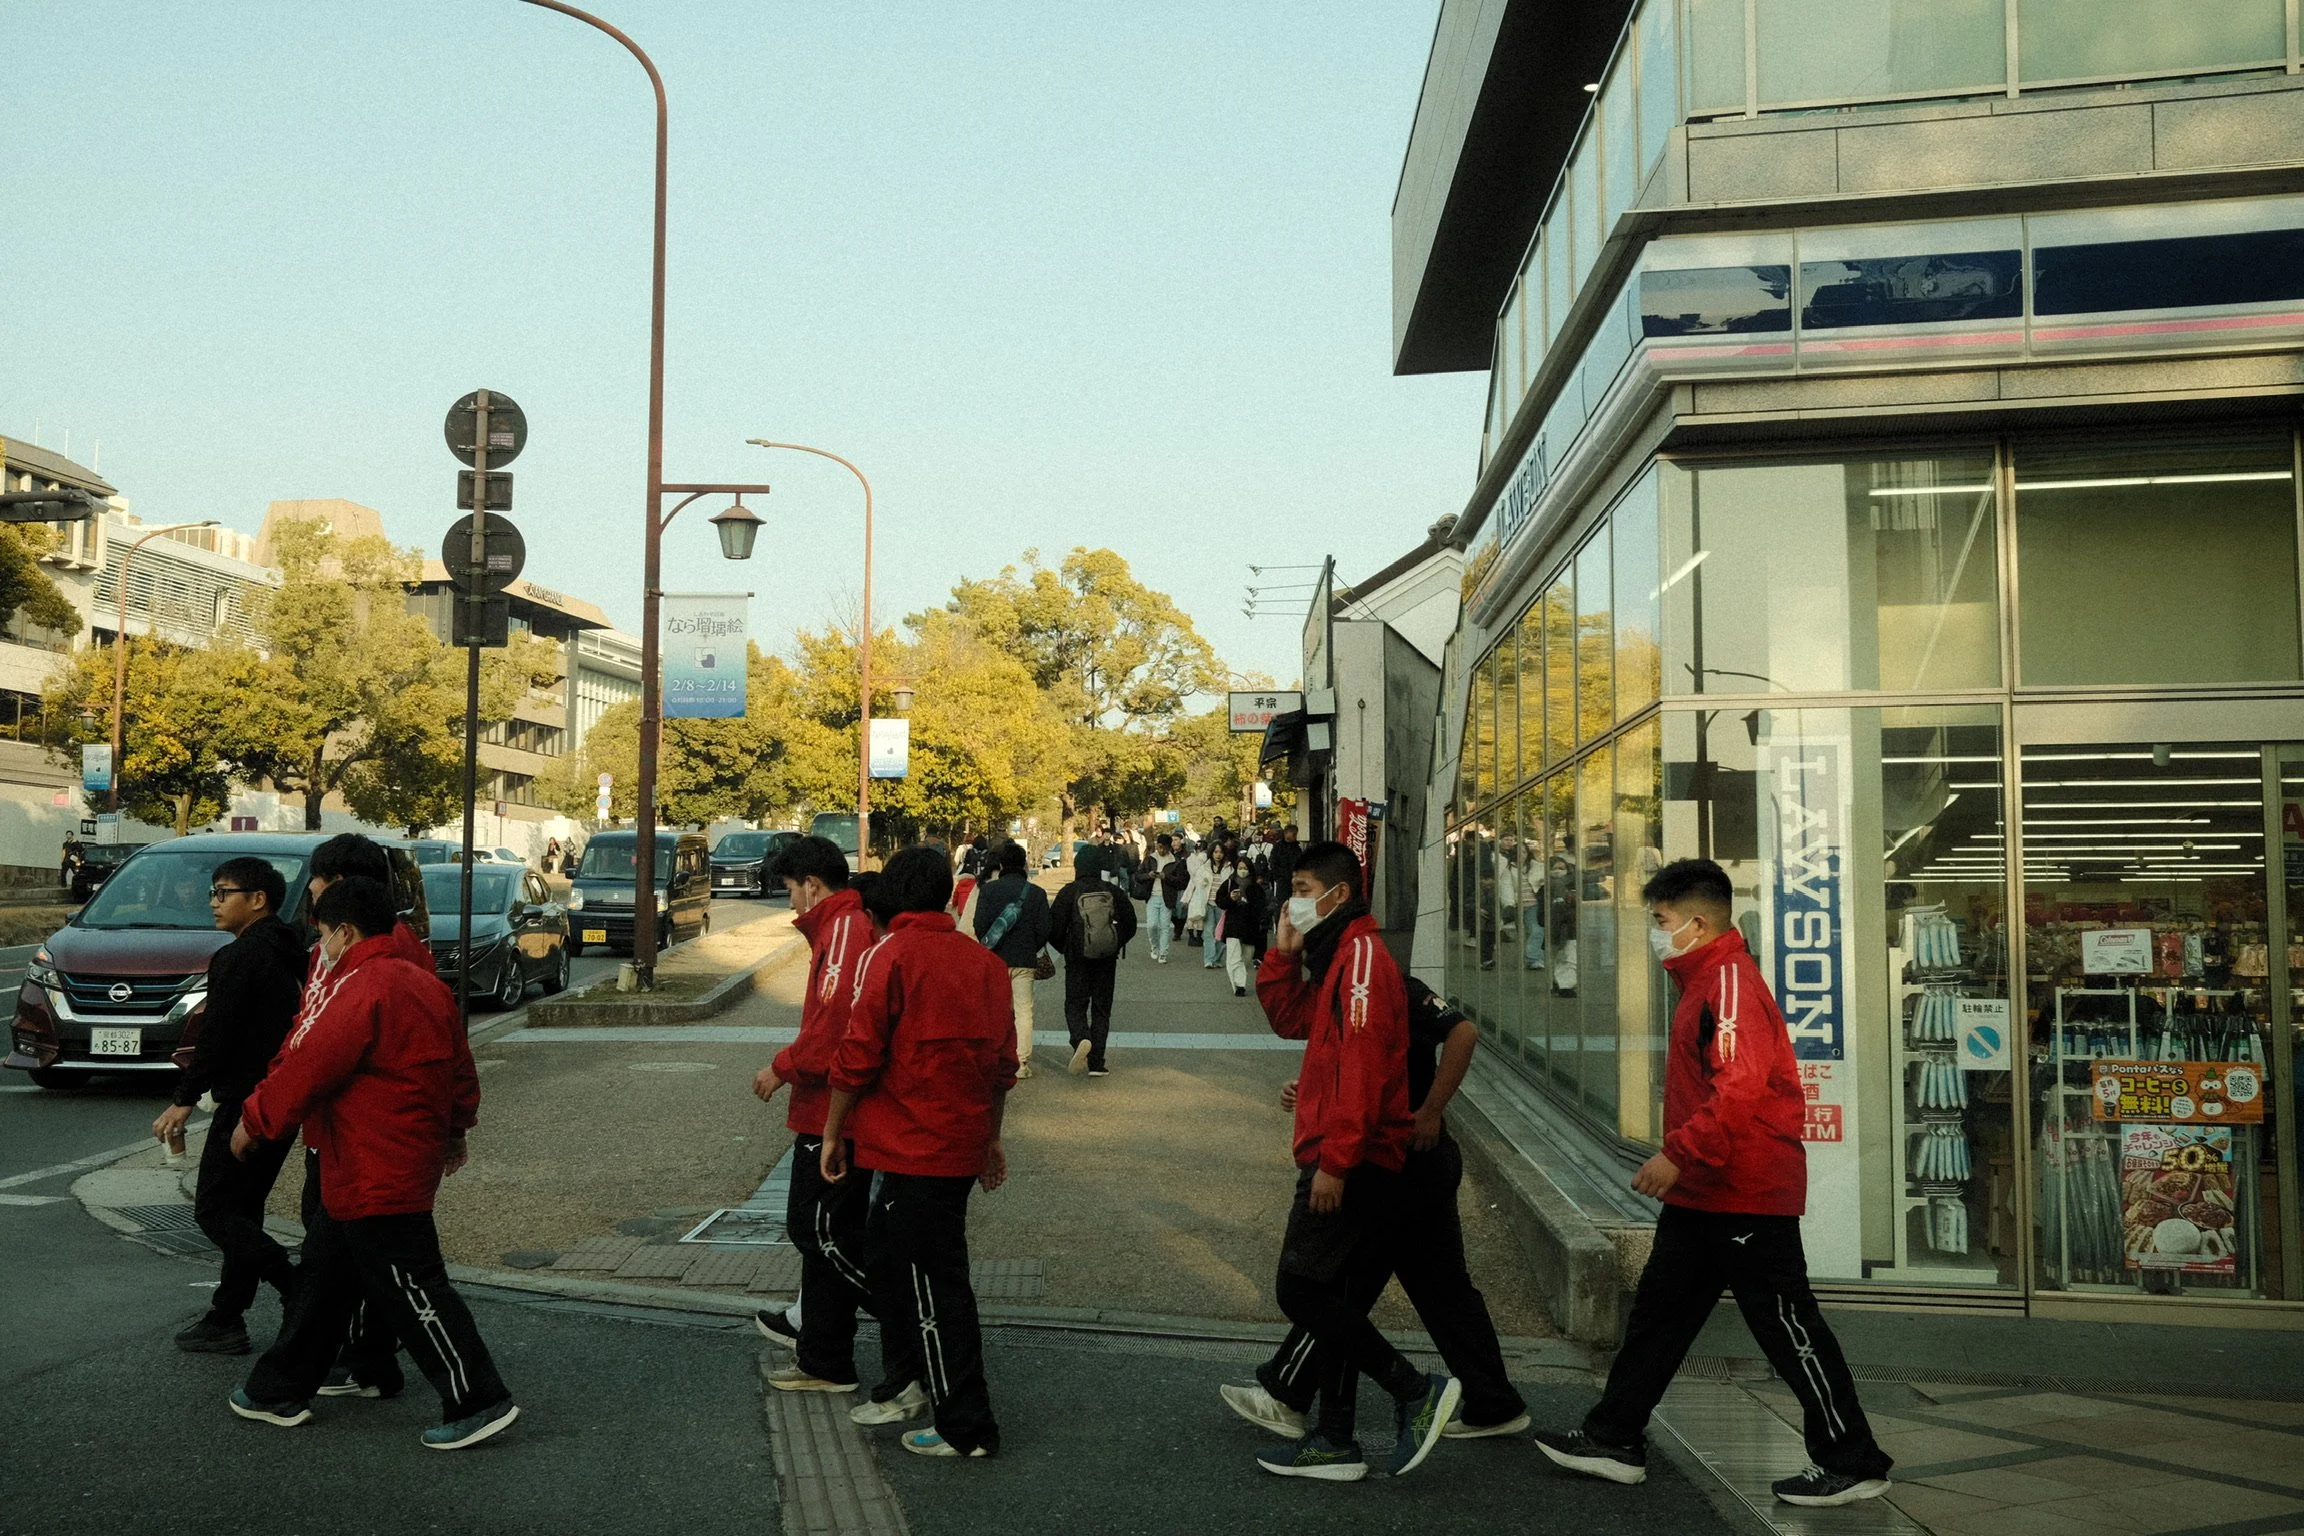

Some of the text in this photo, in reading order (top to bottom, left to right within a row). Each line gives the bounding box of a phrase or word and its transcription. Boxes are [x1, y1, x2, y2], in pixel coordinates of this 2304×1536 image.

[667, 616, 744, 637] なら瑠璃絵
[1254, 697, 1277, 709] 平宗
[1781, 756, 1833, 1044] LAWSON
[1962, 1004, 2004, 1014] 駐輪禁止
[102, 1040, 138, 1053] 85-87
[1805, 1107, 1833, 1122] 行
[1801, 1123, 1836, 1140] TM
